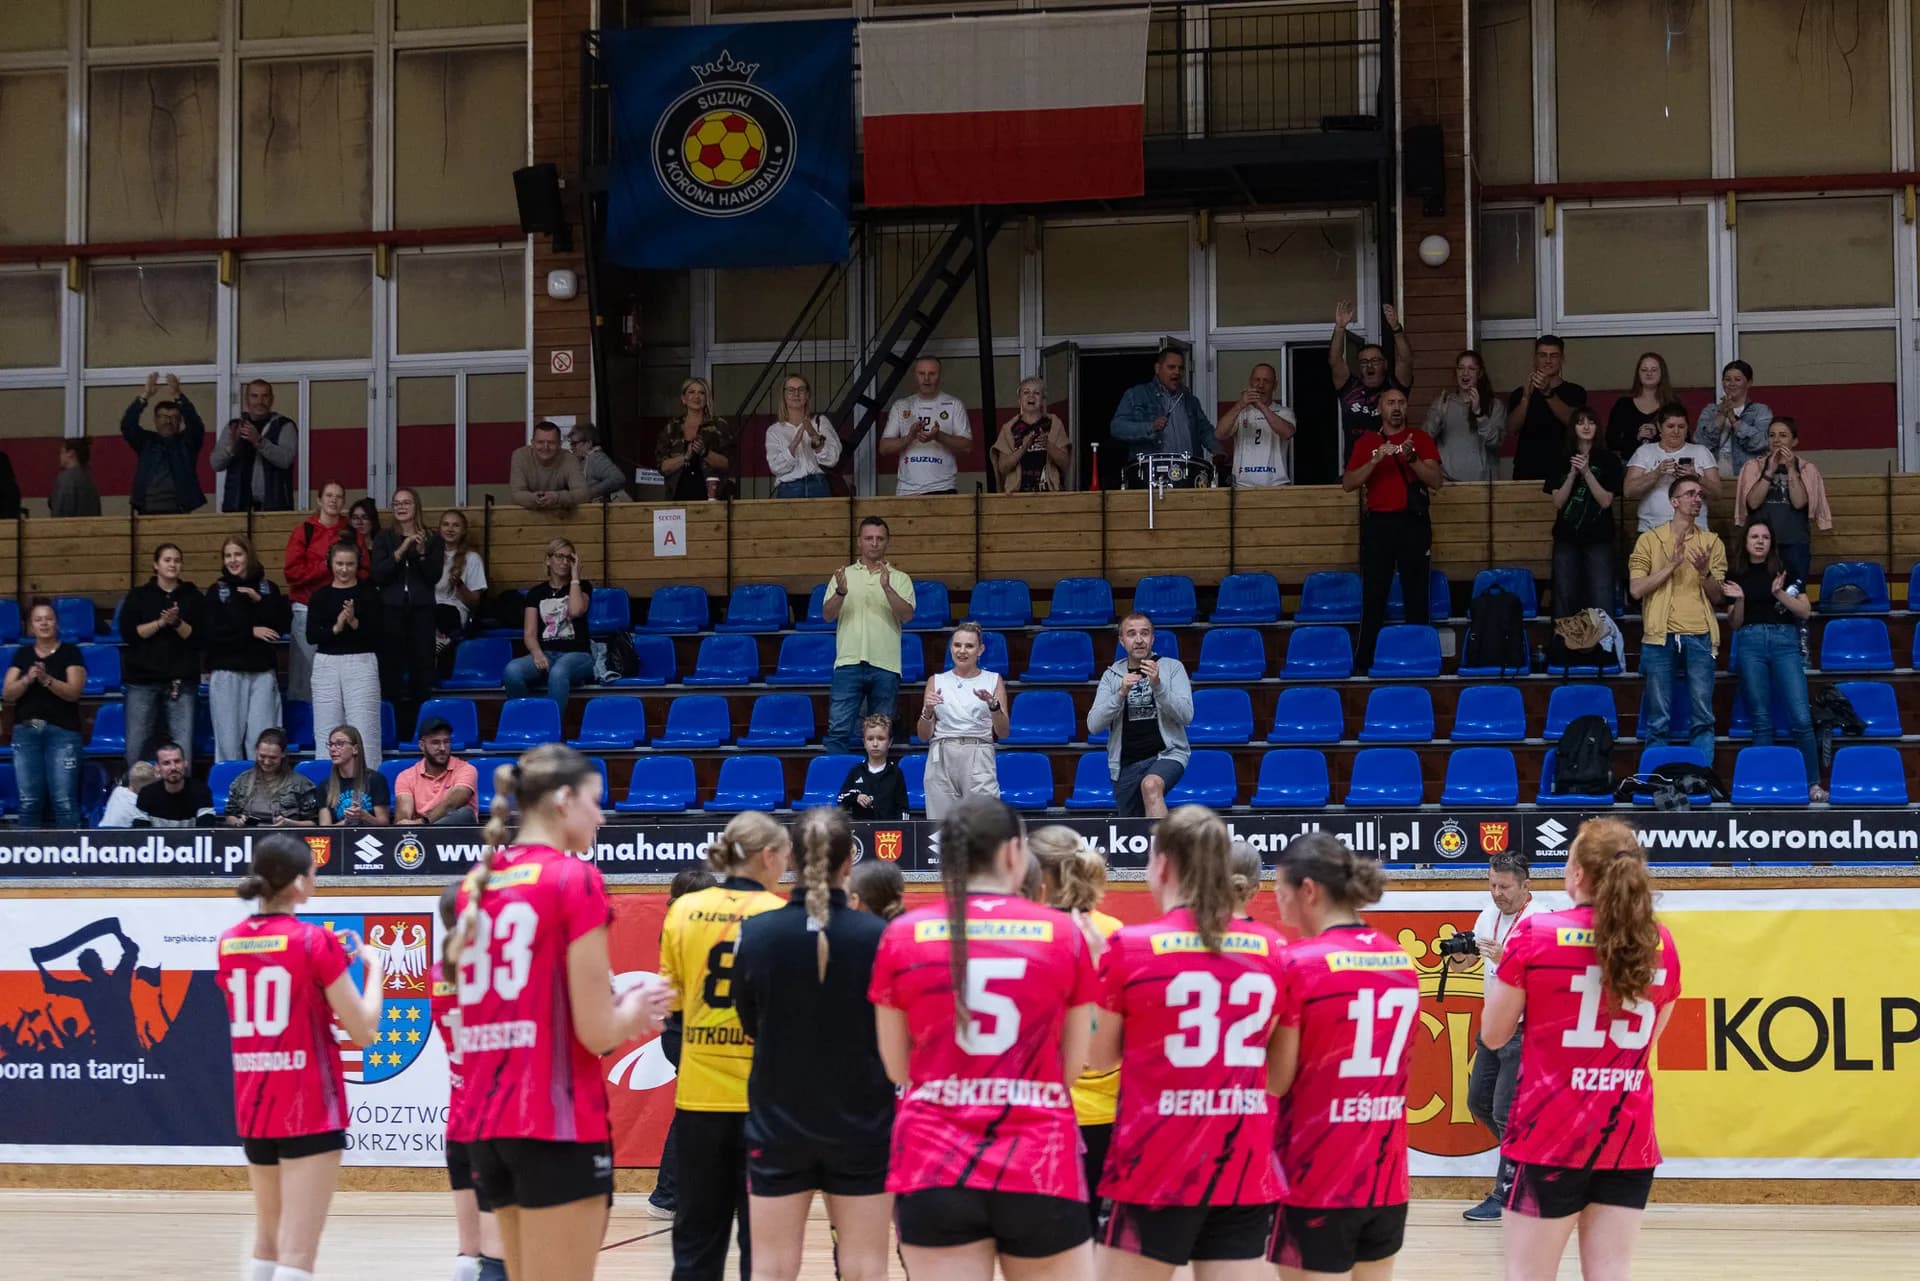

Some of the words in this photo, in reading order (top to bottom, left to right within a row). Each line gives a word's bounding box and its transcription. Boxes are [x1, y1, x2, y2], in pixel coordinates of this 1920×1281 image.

[698, 92, 752, 109] SUZUKI
[665, 161, 715, 205] KORONA
[719, 157, 785, 206] HANDBALL
[1254, 429, 1262, 445] 2
[910, 456, 943, 465] SUZUKI
[1244, 466, 1276, 474] SUZUKI
[663, 530, 676, 546] A
[878, 843, 897, 860] CK
[1482, 835, 1505, 852] CK
[163, 934, 217, 944] targikielce.pl
[226, 965, 292, 1038] 10
[955, 958, 1028, 1056] 5
[1562, 965, 1668, 1050] 15
[1164, 971, 1277, 1068] 32
[1338, 987, 1419, 1078] 17
[1713, 996, 1920, 1073] KOLP
[0, 1063, 44, 1080] ora
[51, 1063, 81, 1080] na
[87, 1057, 165, 1084] targi...
[1571, 1067, 1645, 1092] RZEPKA
